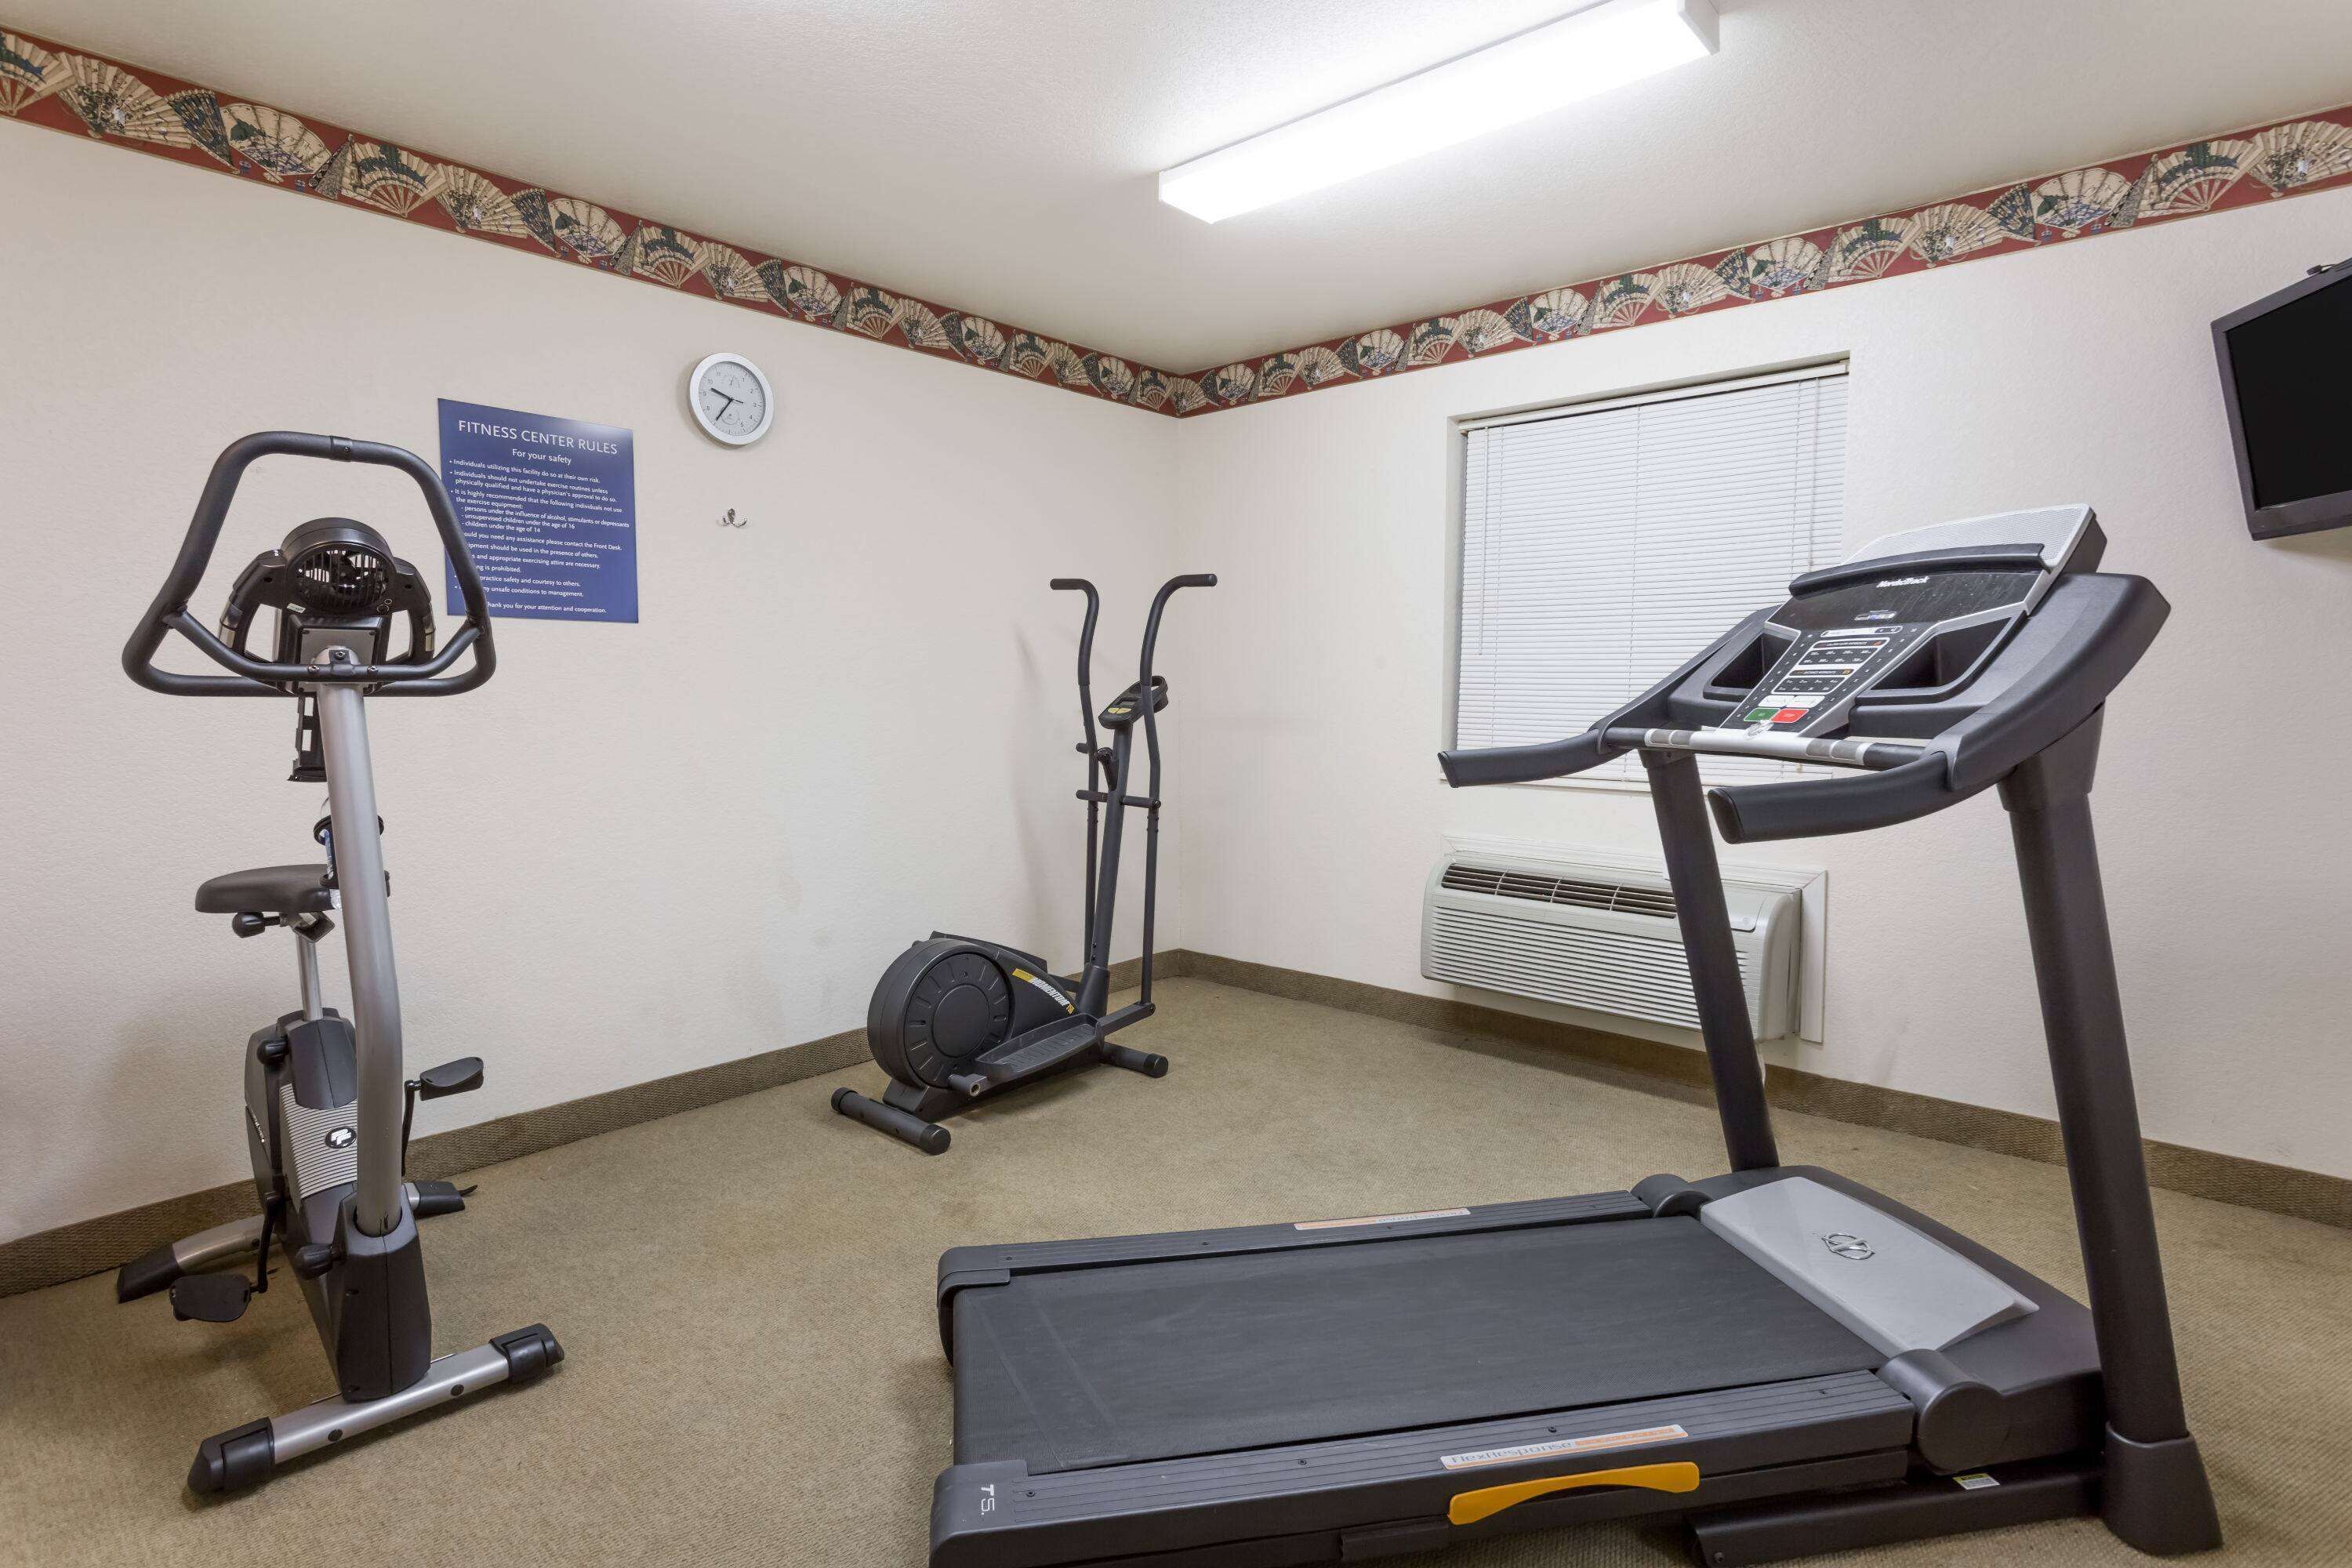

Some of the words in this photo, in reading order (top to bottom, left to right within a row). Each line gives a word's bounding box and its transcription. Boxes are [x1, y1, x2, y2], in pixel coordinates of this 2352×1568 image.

[459, 419, 517, 440] FITNESS
[521, 430, 574, 448] CENTER
[579, 438, 617, 455] RULES
[512, 448, 526, 458] For
[548, 454, 572, 466] safety
[453, 459, 486, 469] Individuals
[487, 463, 510, 473] utilizing
[522, 467, 541, 477] facility
[454, 470, 486, 479] Individuals
[518, 478, 546, 487] undertake
[455, 477, 484, 488] physically
[541, 488, 571, 497] physician's
[466, 489, 485, 499] highly
[486, 493, 527, 502] recommended
[550, 499, 575, 509] following
[464, 514, 502, 522] unsupervised
[568, 516, 594, 524] stimulants
[601, 519, 630, 528] depressants
[1875, 576, 1931, 588] NordicTrack
[1450, 1440, 1573, 1464] FlexResponse
